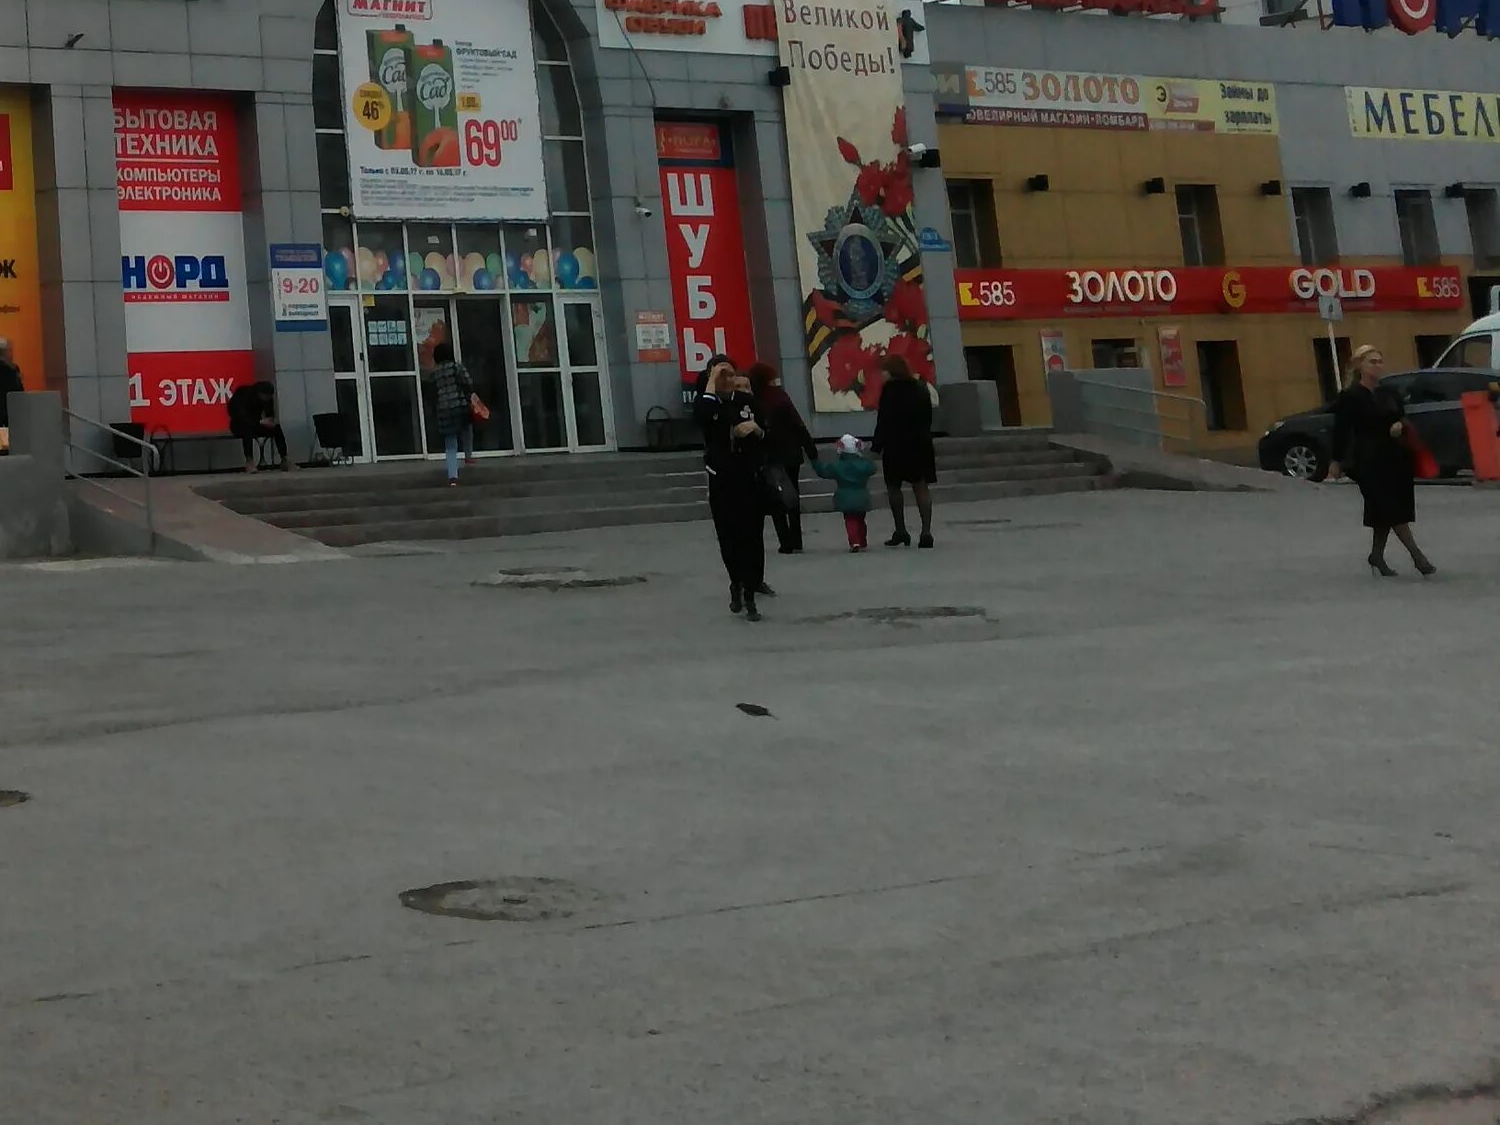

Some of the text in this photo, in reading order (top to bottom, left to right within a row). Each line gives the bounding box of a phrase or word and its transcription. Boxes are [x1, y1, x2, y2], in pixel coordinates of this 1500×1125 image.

[788, 39, 895, 76] Победы!
[984, 71, 1017, 95] 585
[1022, 71, 1140, 105] ЗОЛОТО
[113, 107, 218, 131] БЫТОВАЯ
[1364, 90, 1500, 137] МЕБЕЛ
[114, 132, 219, 156] ТЕХНИКА
[464, 118, 503, 168] 69
[116, 185, 222, 202] ЭЛЕКТРОНИКА
[121, 254, 230, 289] НОРД
[282, 277, 320, 294] 9-20
[666, 173, 728, 373] ШУБЫ
[979, 281, 1016, 308] 585
[1067, 270, 1177, 304] ЗОЛОТО
[1289, 268, 1376, 300] GOLD
[1432, 276, 1460, 299] 585
[128, 372, 234, 407] 1 ЭТАЖ
